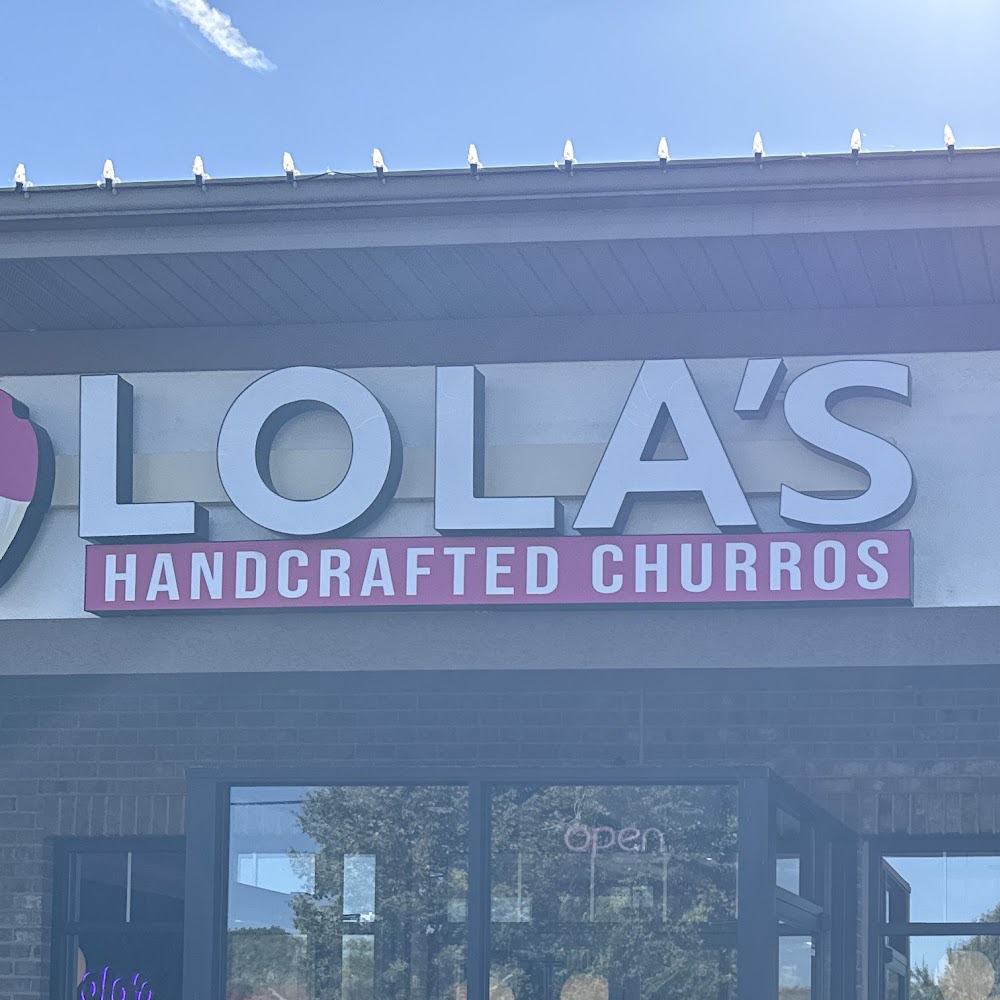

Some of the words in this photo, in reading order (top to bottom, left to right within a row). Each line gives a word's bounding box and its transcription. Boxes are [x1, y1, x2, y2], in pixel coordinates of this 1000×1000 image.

[78, 358, 914, 539] LOLA'S
[104, 546, 559, 602] HANDCRAFTED
[591, 539, 889, 594] CHURROS
[564, 824, 665, 858] open
